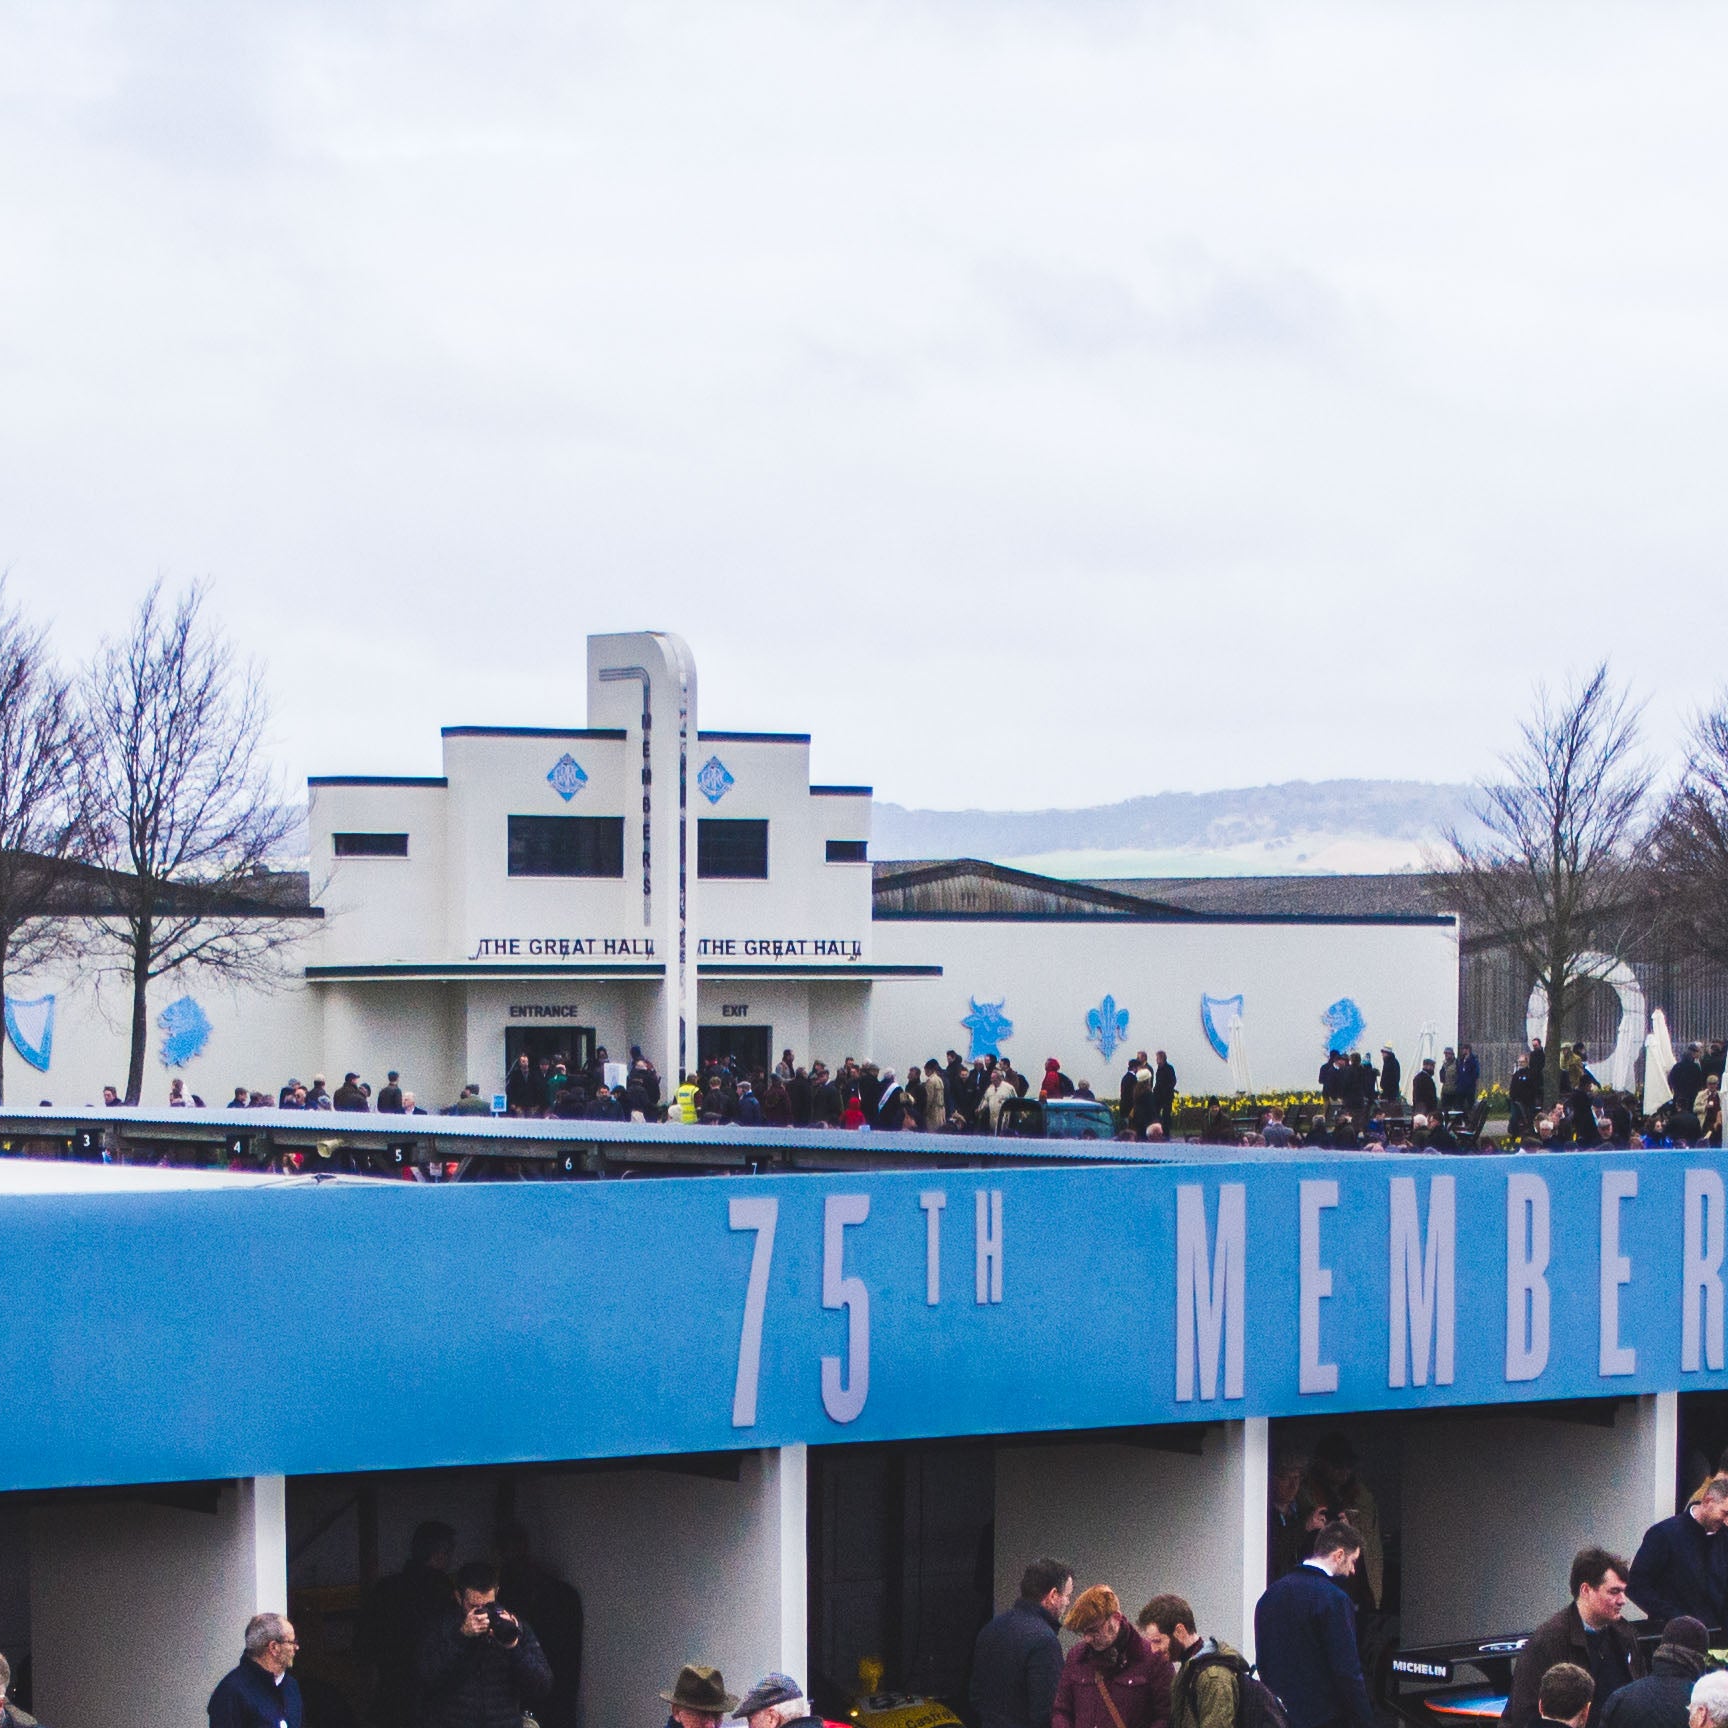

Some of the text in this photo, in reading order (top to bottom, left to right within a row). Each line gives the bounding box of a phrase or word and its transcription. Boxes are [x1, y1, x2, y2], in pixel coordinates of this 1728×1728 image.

[481, 939, 655, 956] THE GREAT HALL
[700, 940, 862, 957] THE GREAT HALL
[510, 1005, 578, 1018] ENTRANCE
[722, 1005, 749, 1018] EXIT
[1392, 1660, 1447, 1678] MICHELIN
